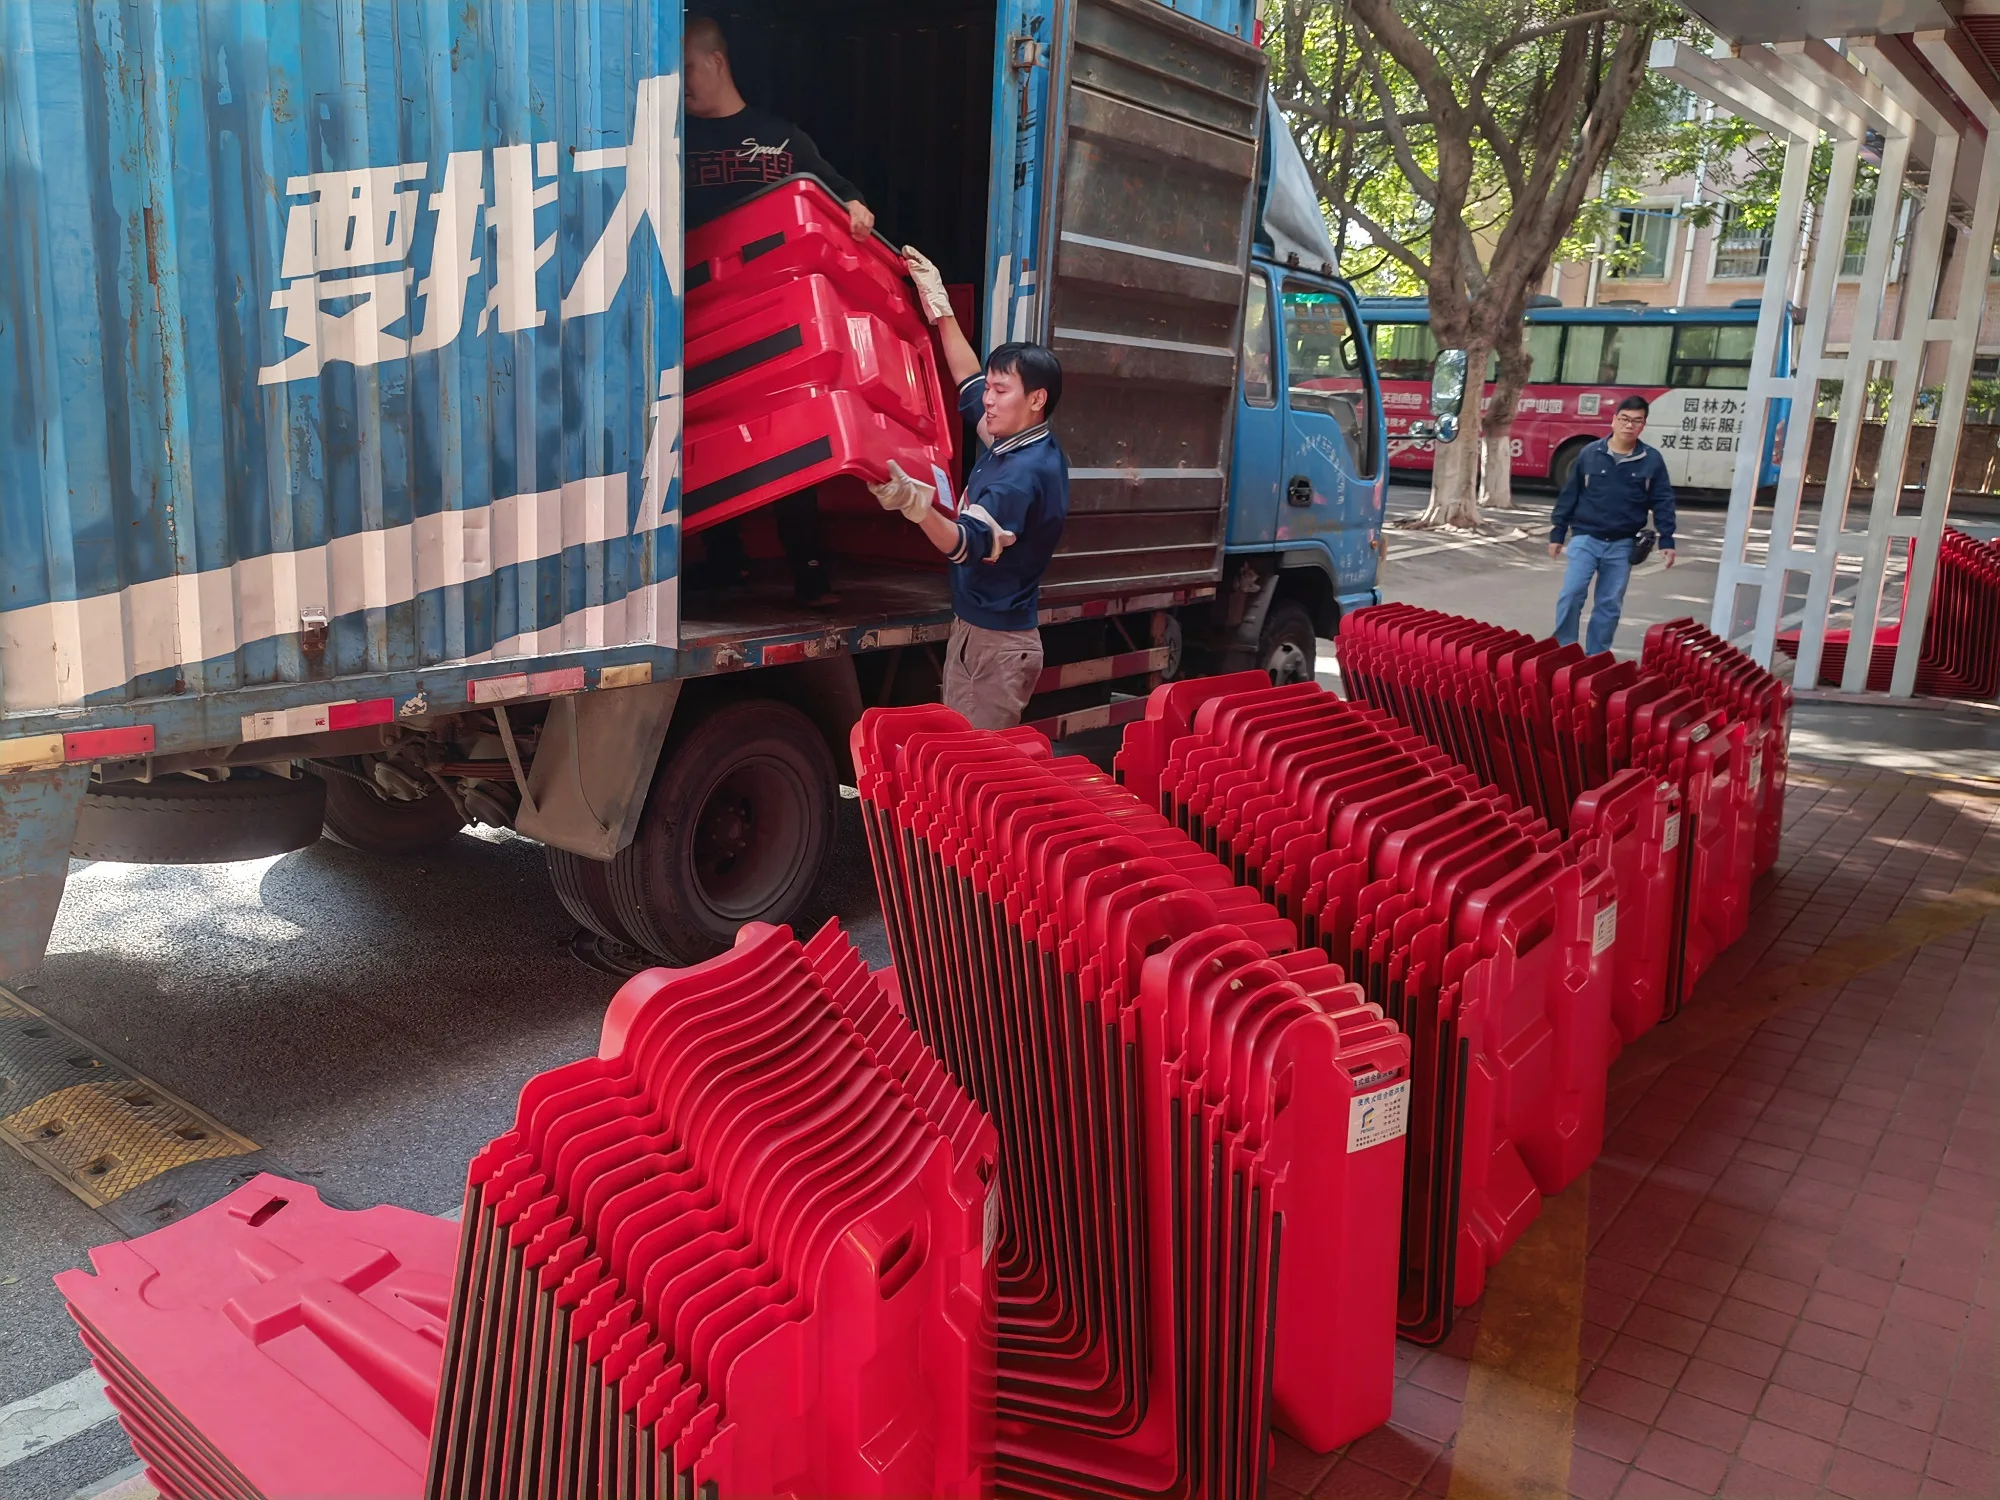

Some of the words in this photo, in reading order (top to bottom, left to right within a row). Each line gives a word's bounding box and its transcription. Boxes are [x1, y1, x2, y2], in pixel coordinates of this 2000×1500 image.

[736, 137, 790, 163] Speed
[1660, 434, 1740, 452] 双生态园
